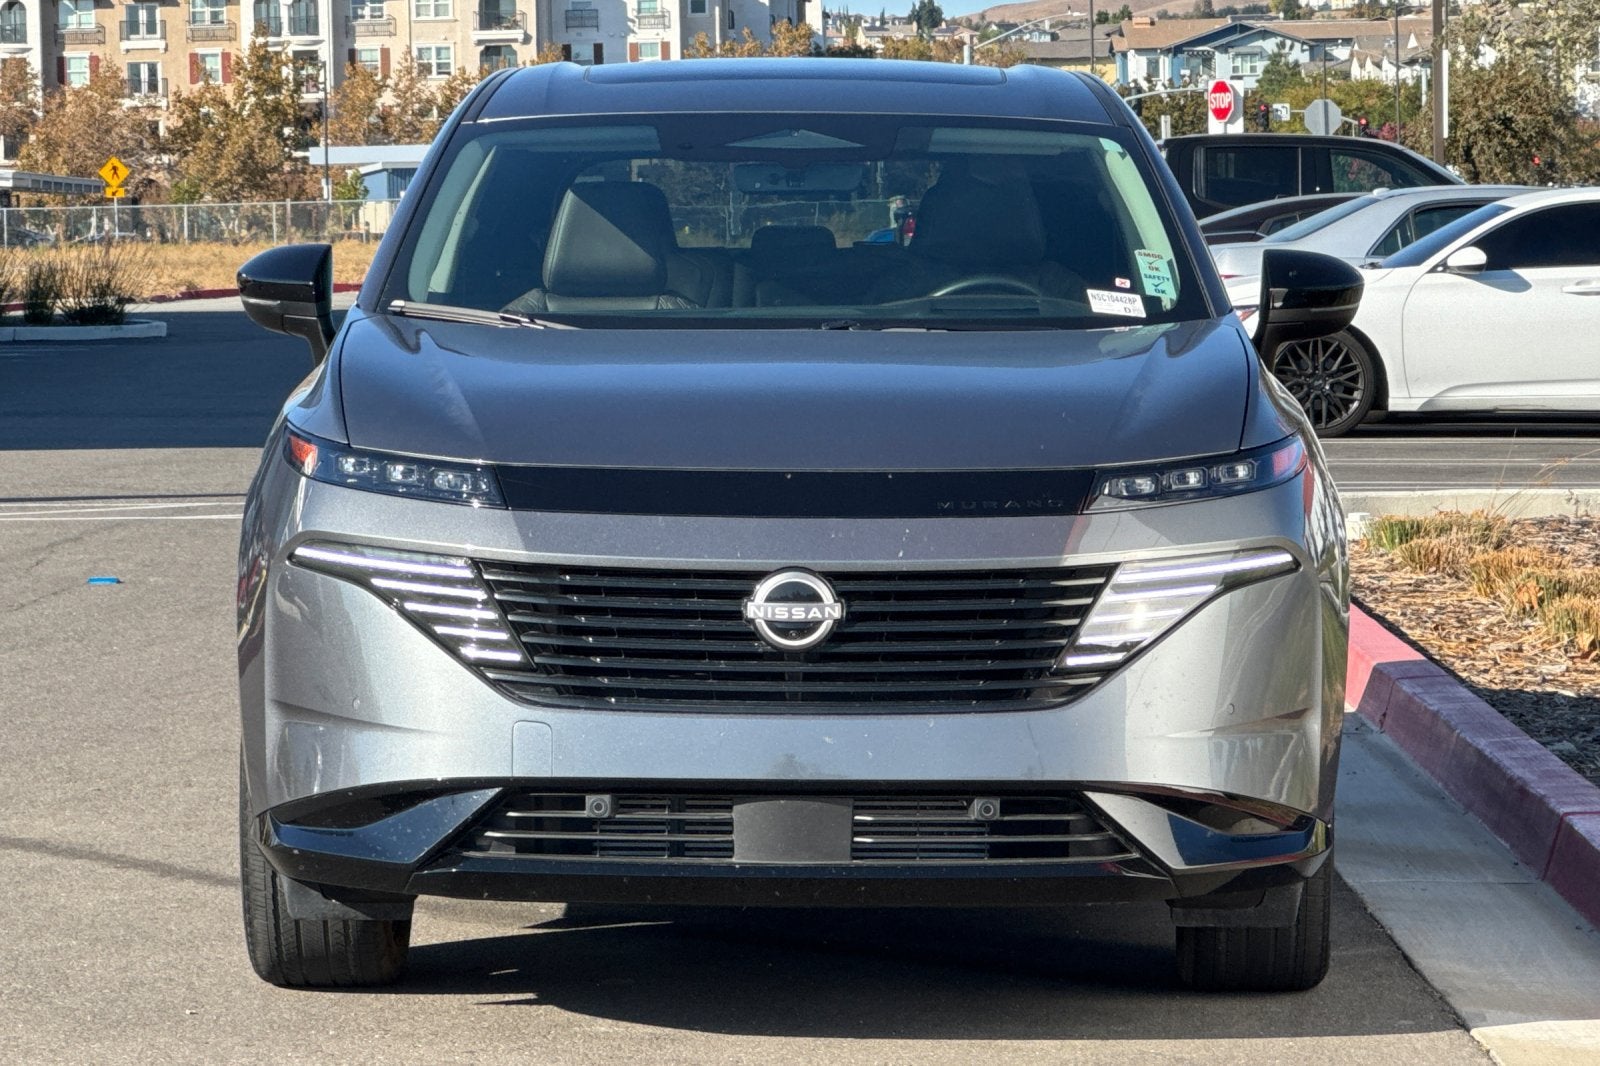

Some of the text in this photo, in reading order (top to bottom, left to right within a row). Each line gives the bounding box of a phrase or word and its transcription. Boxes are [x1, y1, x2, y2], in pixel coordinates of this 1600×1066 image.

[1210, 92, 1232, 109] STOP
[1137, 251, 1163, 260] SMOG
[1143, 273, 1170, 282] SAFETY
[937, 499, 1063, 510] MURANO
[750, 605, 839, 619] NISSAN
